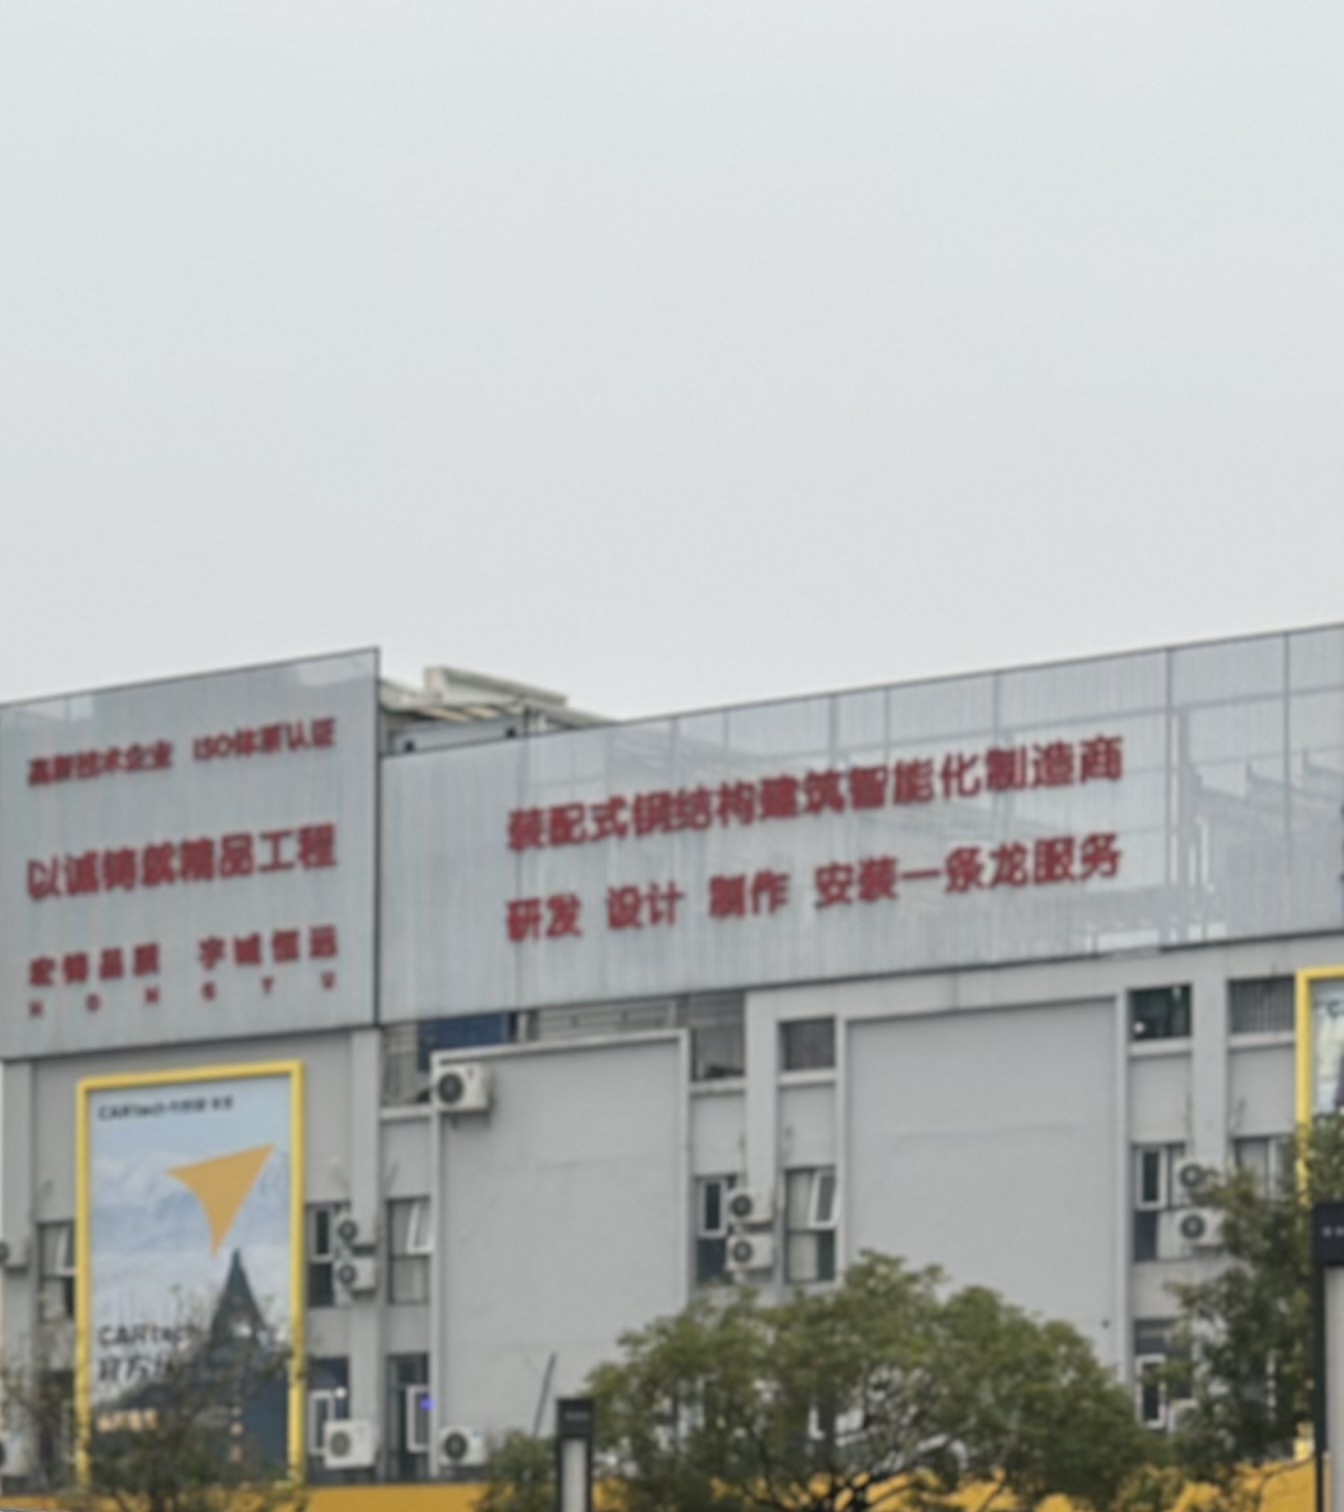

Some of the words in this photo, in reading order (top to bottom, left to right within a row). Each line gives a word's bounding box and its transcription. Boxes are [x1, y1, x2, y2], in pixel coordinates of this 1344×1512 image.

[506, 893, 582, 943] 研发
[606, 880, 685, 930] 设计
[707, 867, 791, 919] 制作
[813, 832, 1121, 909] 安装一条龙服务
